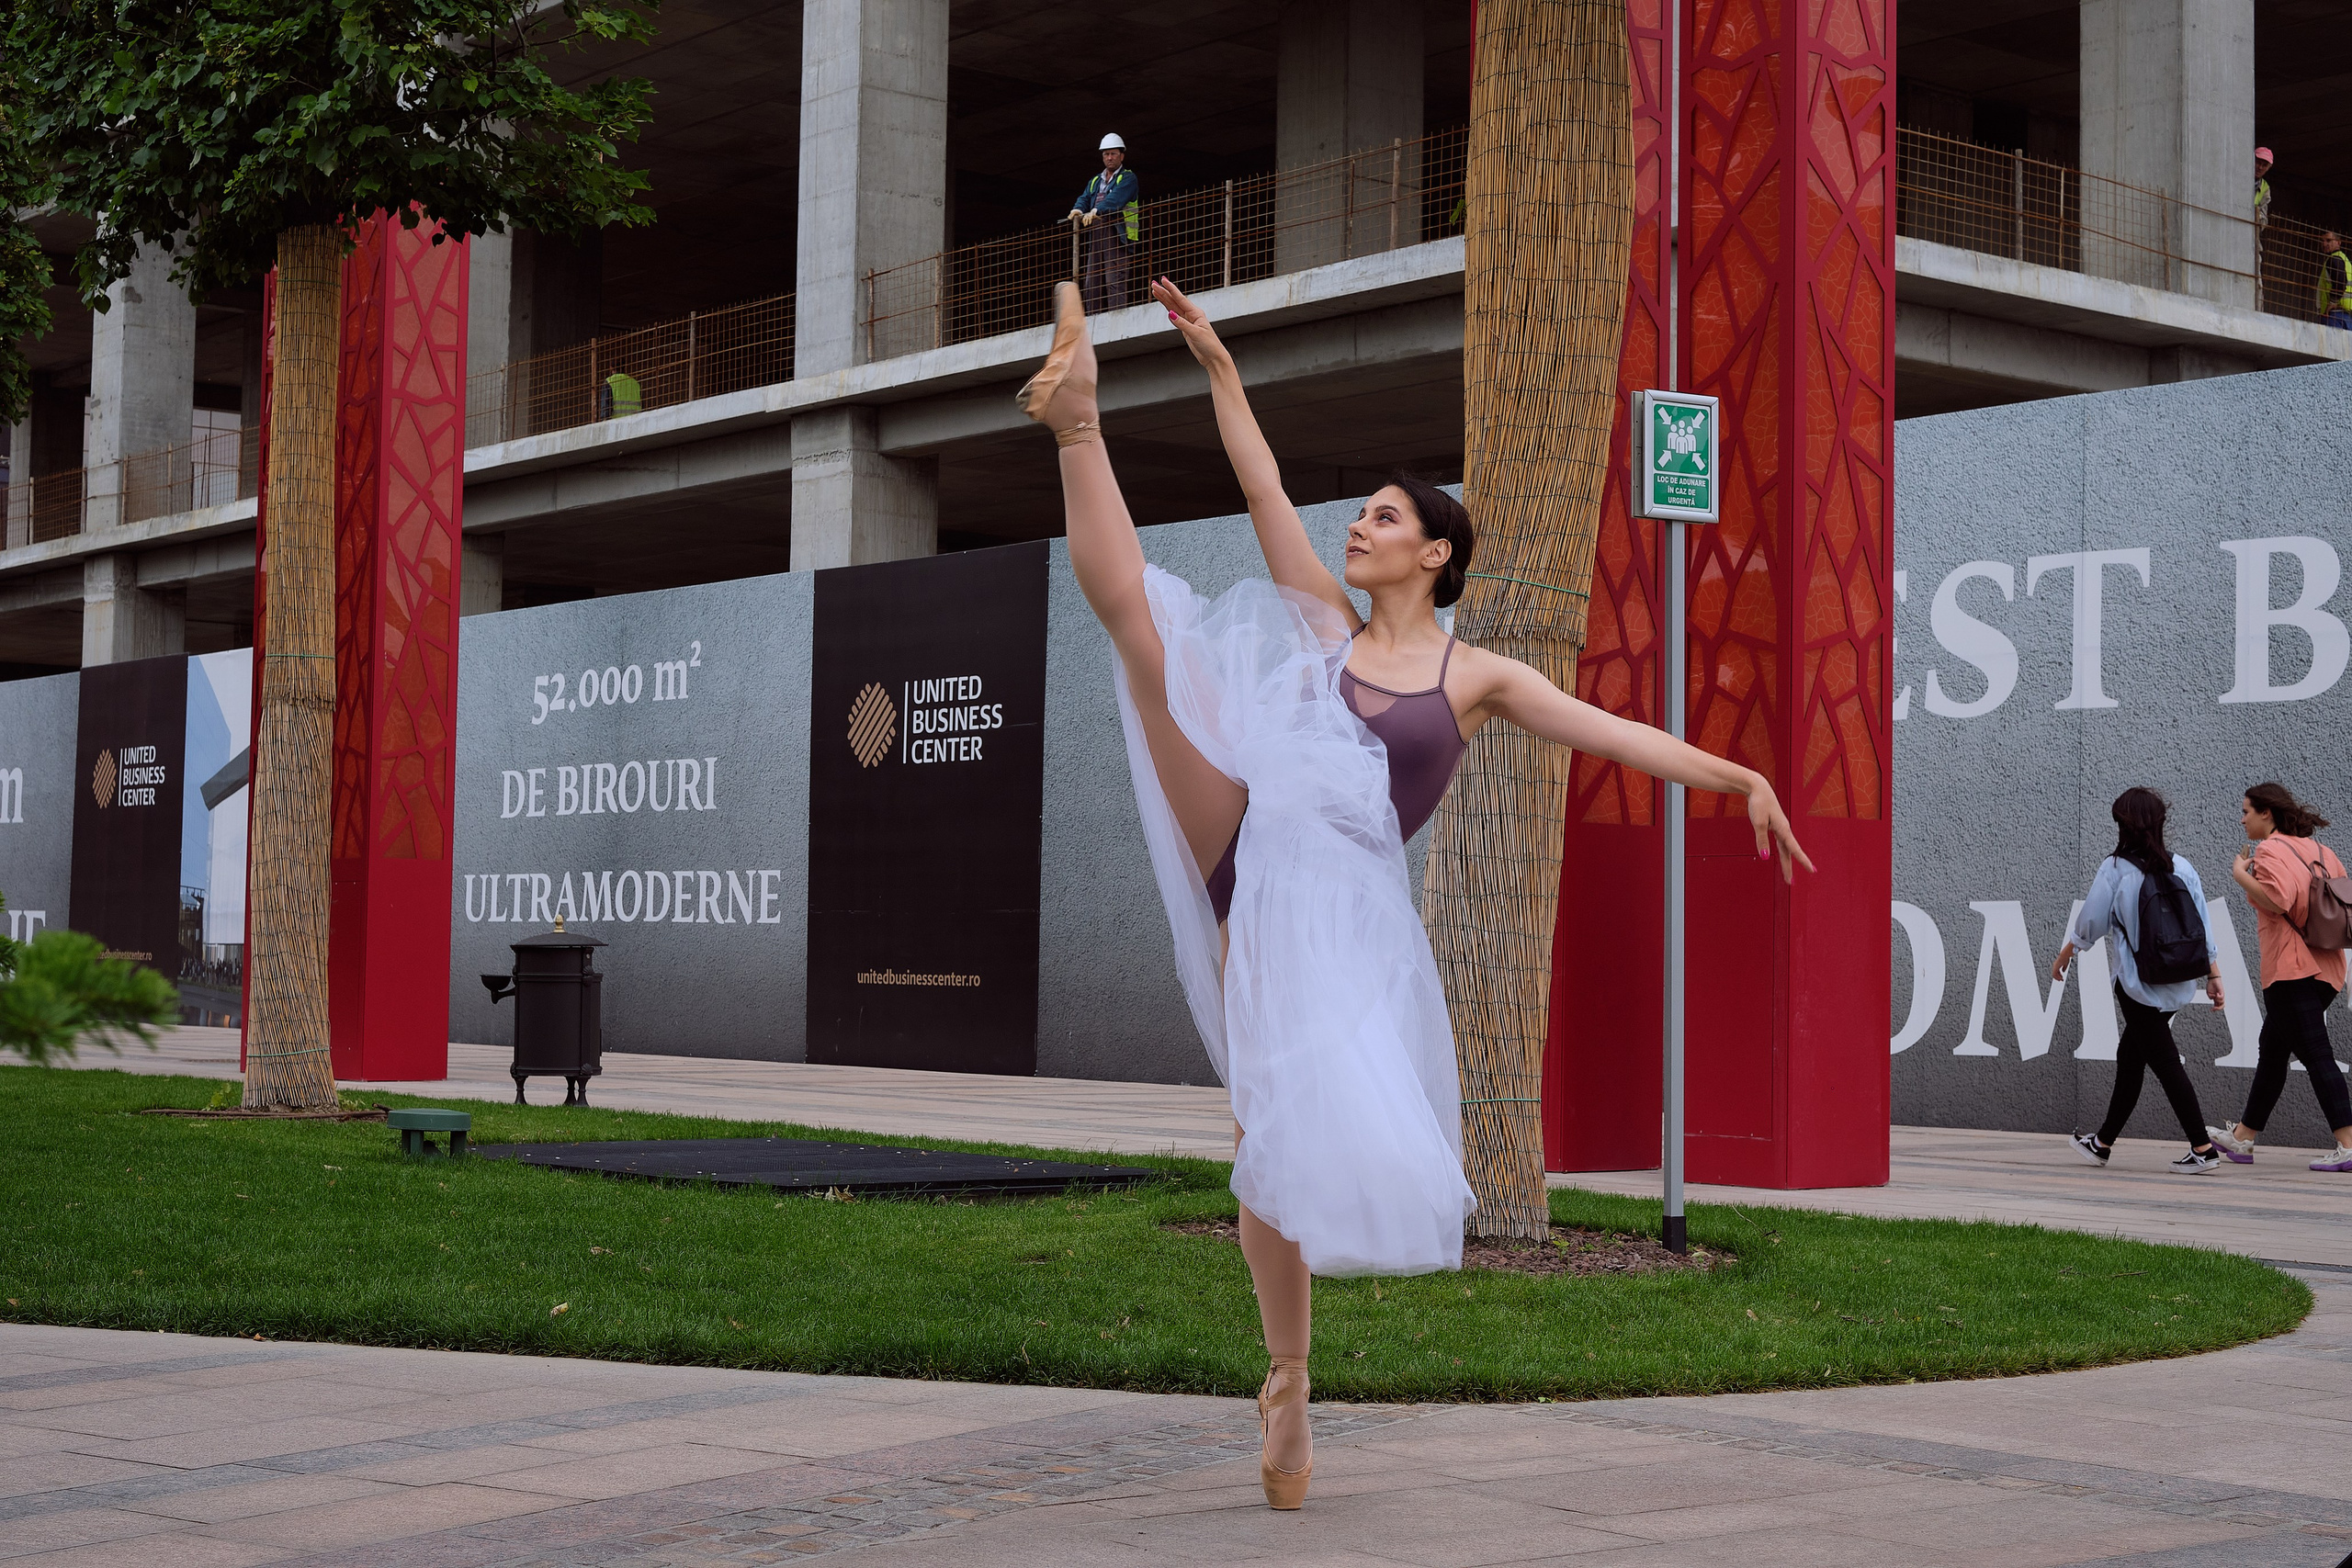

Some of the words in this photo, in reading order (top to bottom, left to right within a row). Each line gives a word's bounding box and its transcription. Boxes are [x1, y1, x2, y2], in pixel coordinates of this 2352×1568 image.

[1668, 485, 1674, 493] ÎN
[1679, 478, 1706, 487] ADUNARE
[1893, 546, 2151, 721] ST
[531, 664, 643, 725] 52.000
[913, 675, 982, 705] UNITED
[912, 704, 1003, 734] BUSINESS
[124, 745, 156, 765] UNITED
[910, 736, 983, 764] CENTER
[122, 765, 165, 786] BUSINESS
[500, 768, 547, 818] DE
[556, 757, 718, 816] BIROURI
[122, 787, 155, 807] CENTER
[464, 870, 781, 925] ULTRAMODERNE
[857, 968, 980, 987] unitedbusinesscenter.ro
